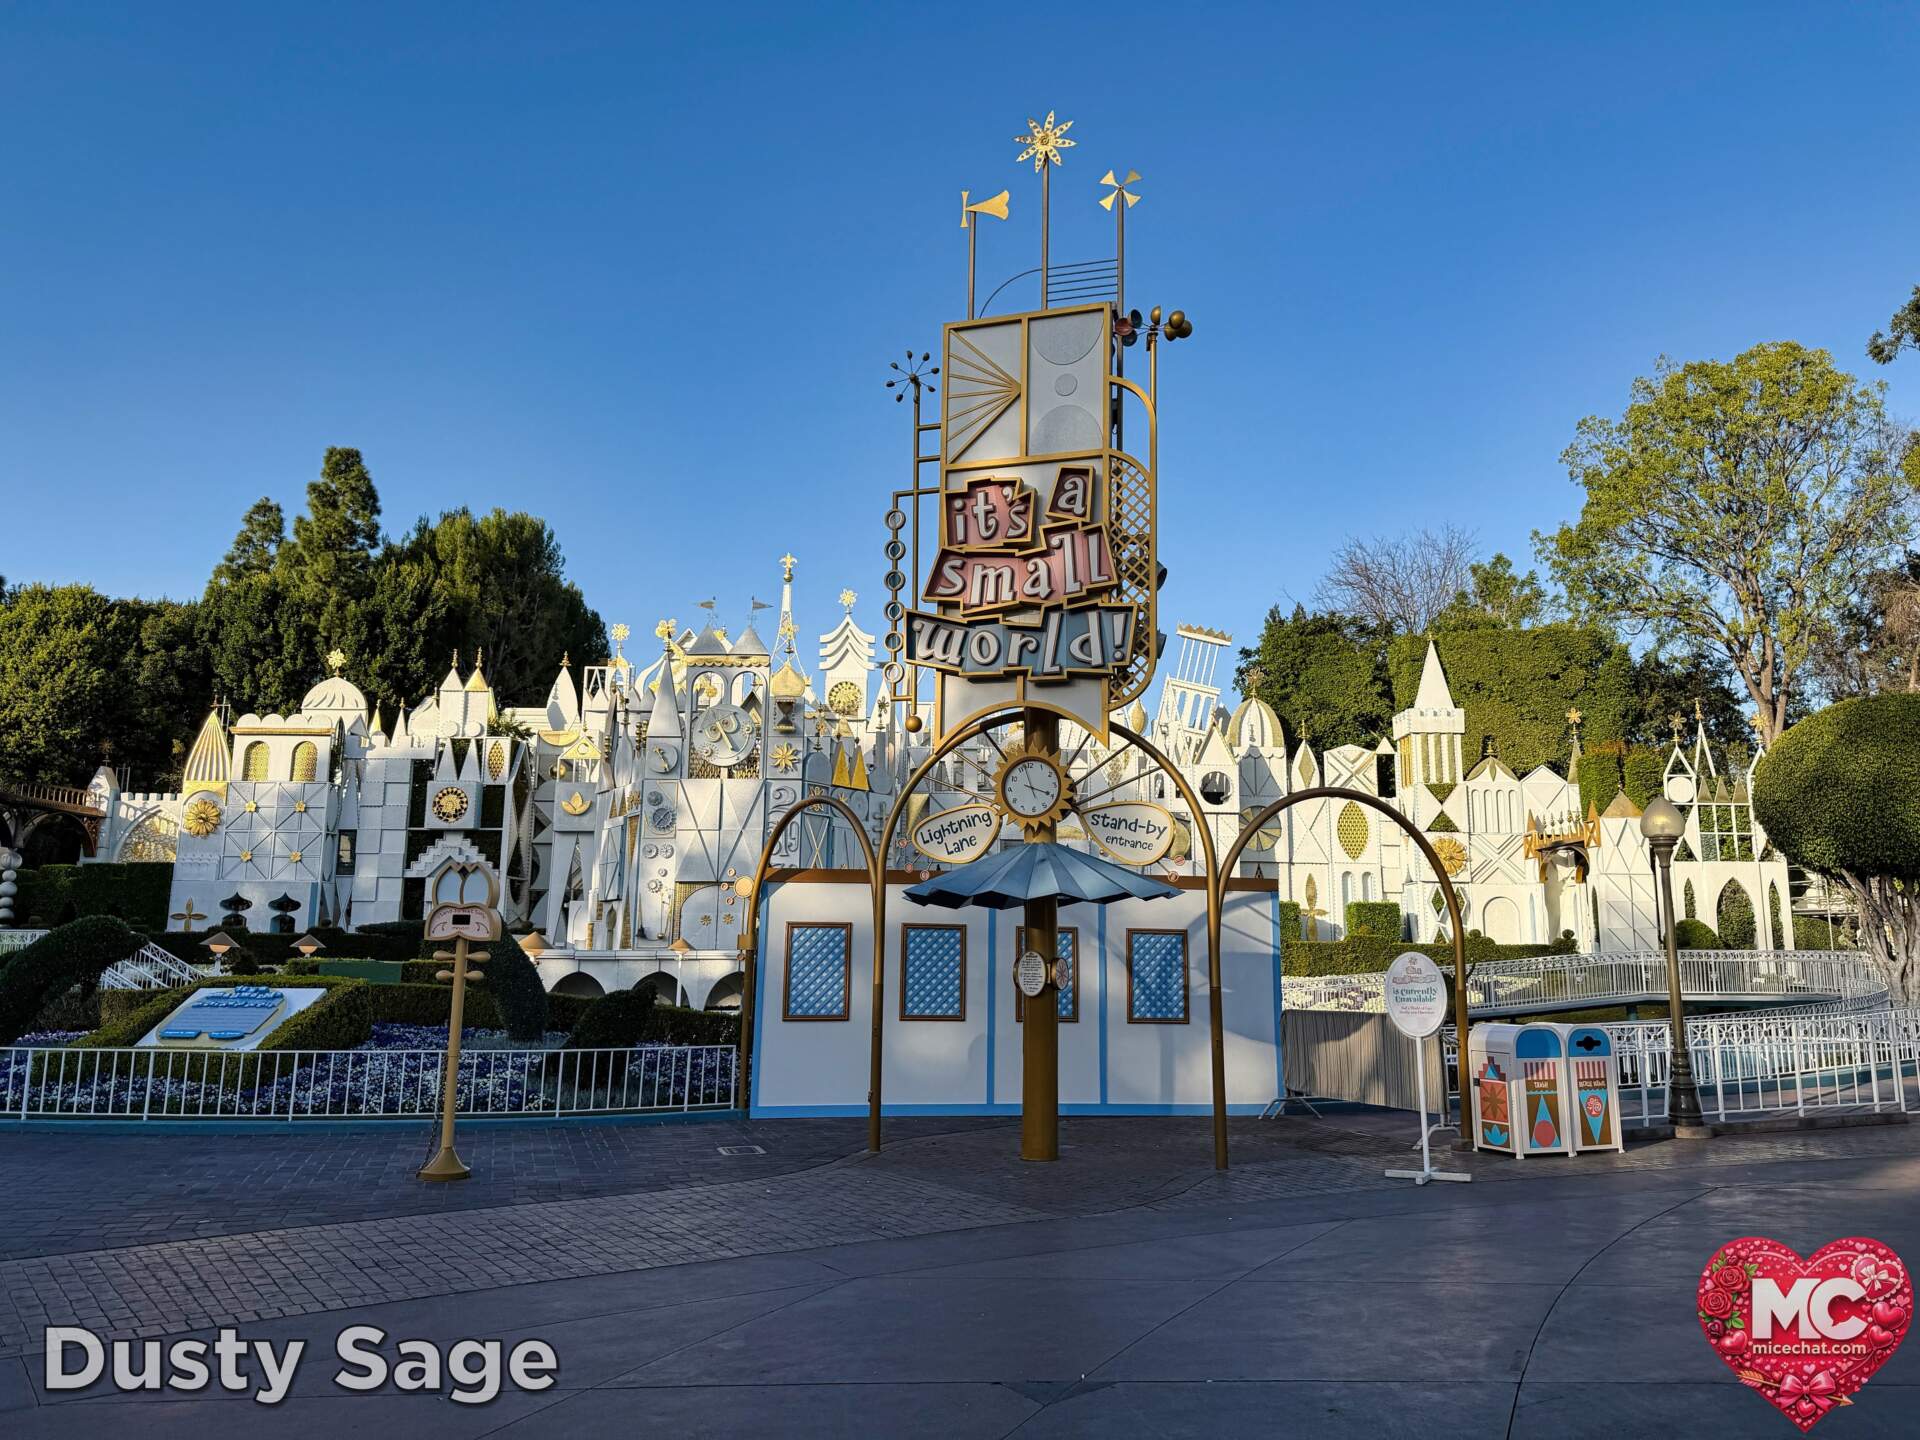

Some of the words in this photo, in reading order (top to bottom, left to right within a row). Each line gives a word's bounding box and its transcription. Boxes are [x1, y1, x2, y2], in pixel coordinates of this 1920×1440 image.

[953, 486, 1028, 543] it's
[1057, 476, 1088, 516] a
[935, 532, 1110, 606] small
[912, 611, 1128, 675] world!
[920, 810, 993, 845] Lightning
[1090, 812, 1168, 840] stand-by
[1105, 835, 1154, 852] entrance
[944, 835, 978, 856] Lane
